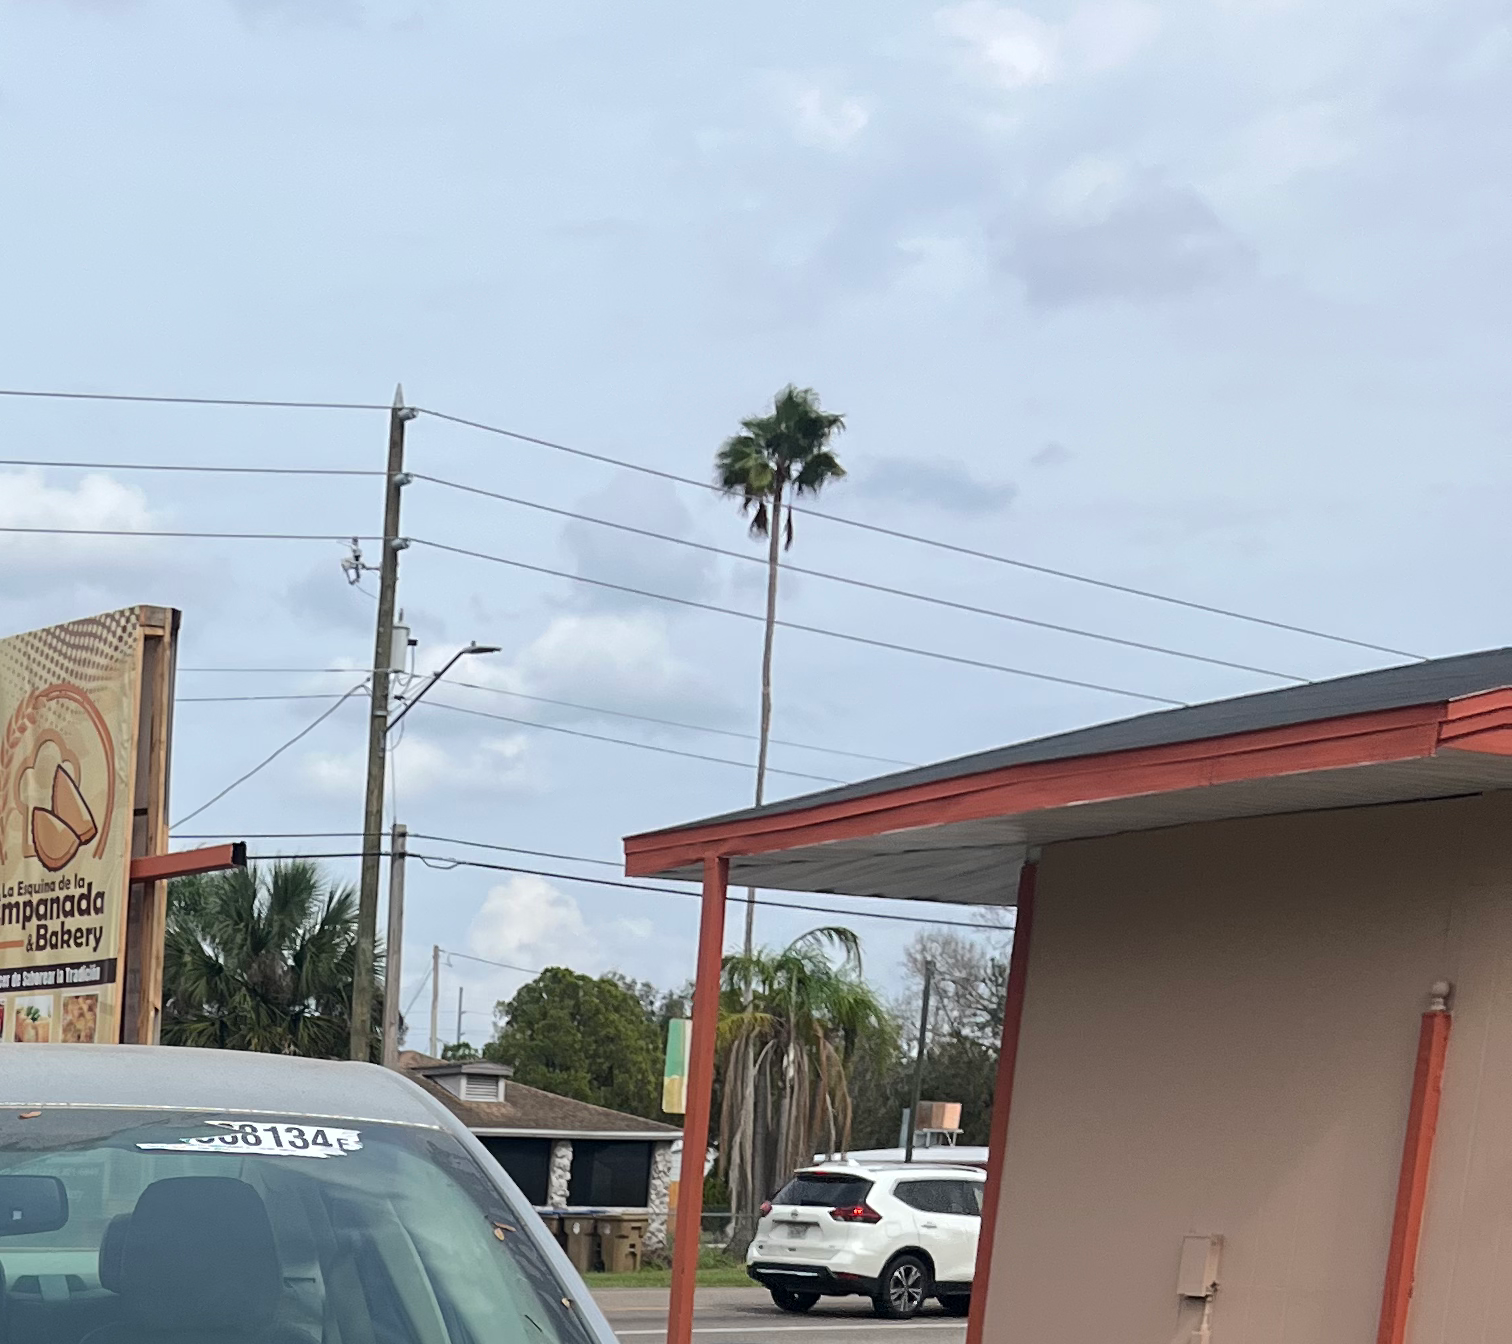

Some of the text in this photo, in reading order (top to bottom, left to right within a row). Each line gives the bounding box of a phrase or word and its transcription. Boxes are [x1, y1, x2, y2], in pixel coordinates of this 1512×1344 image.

[2, 873, 85, 898] La Esquina de la
[26, 921, 103, 952] & Bakery
